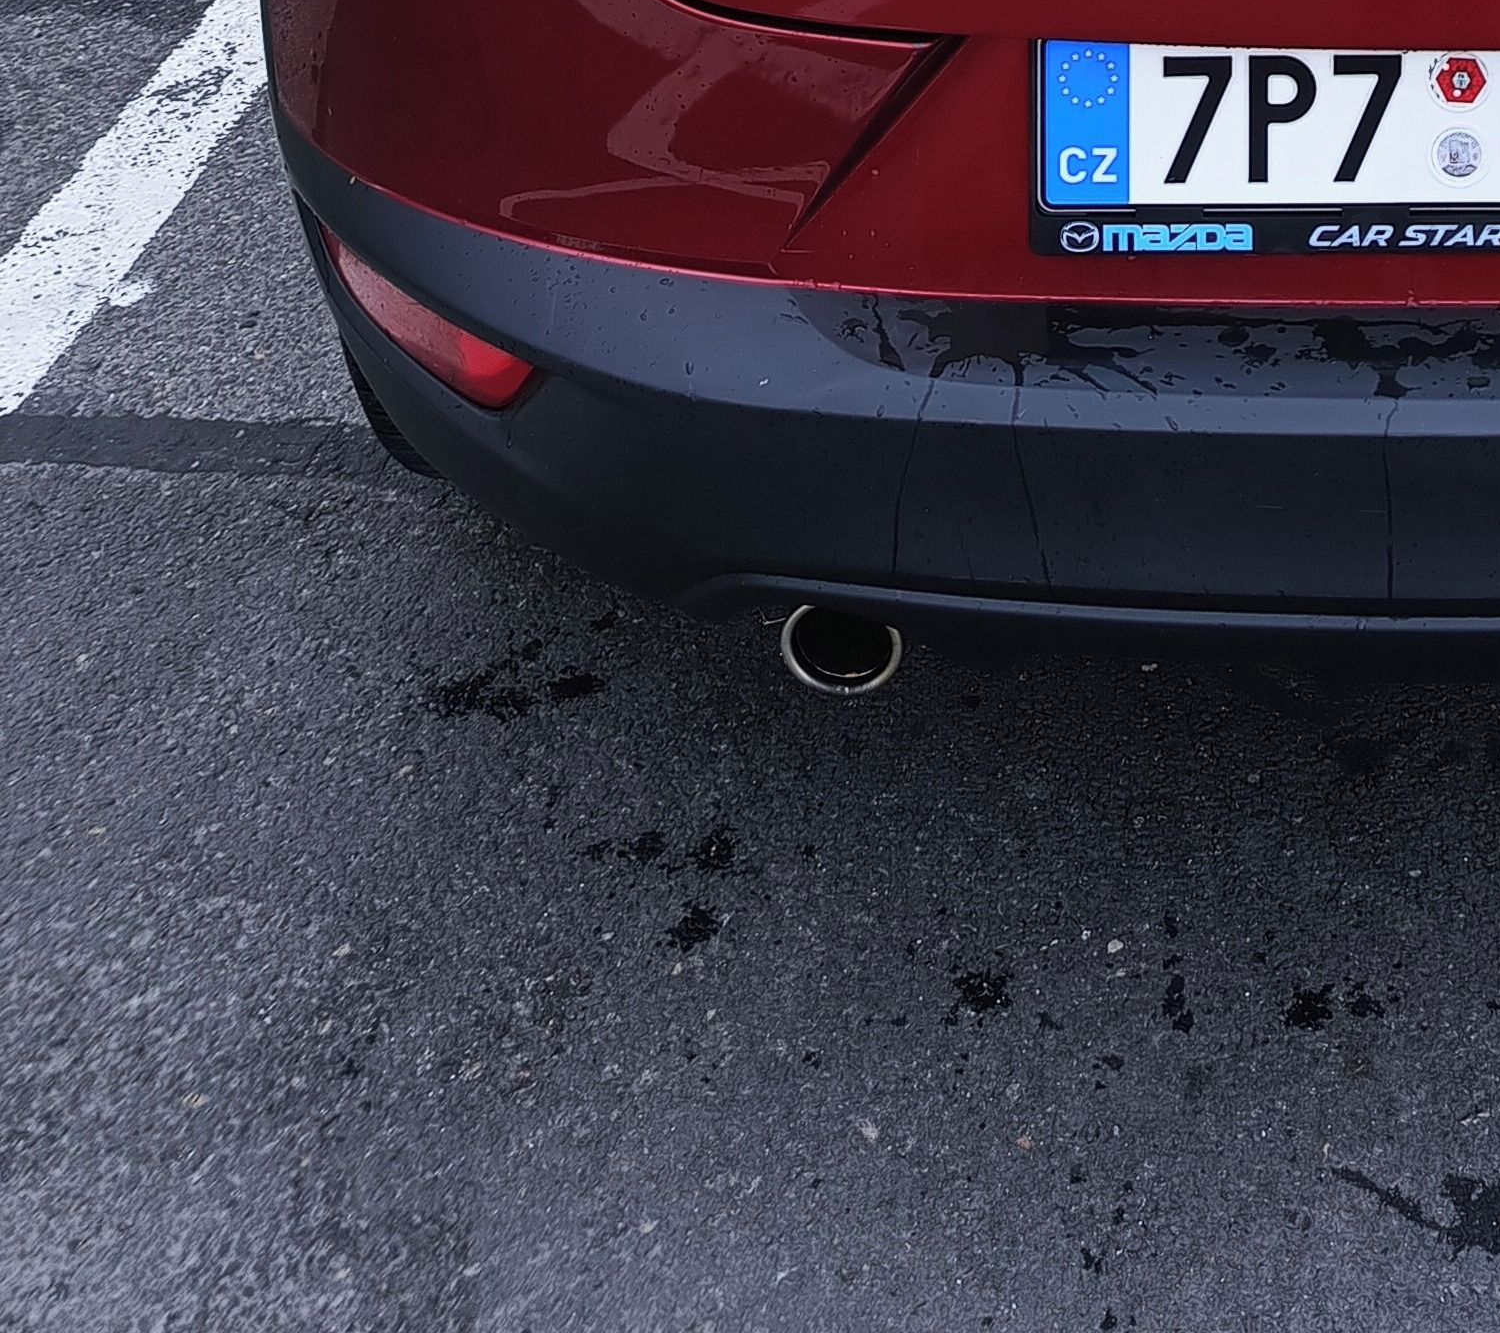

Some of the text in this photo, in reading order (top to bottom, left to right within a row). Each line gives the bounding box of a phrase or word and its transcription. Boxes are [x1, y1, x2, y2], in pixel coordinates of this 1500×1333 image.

[1161, 54, 1403, 185] 7P7
[1057, 146, 1120, 184] CZ
[1308, 224, 1394, 249] CAR
